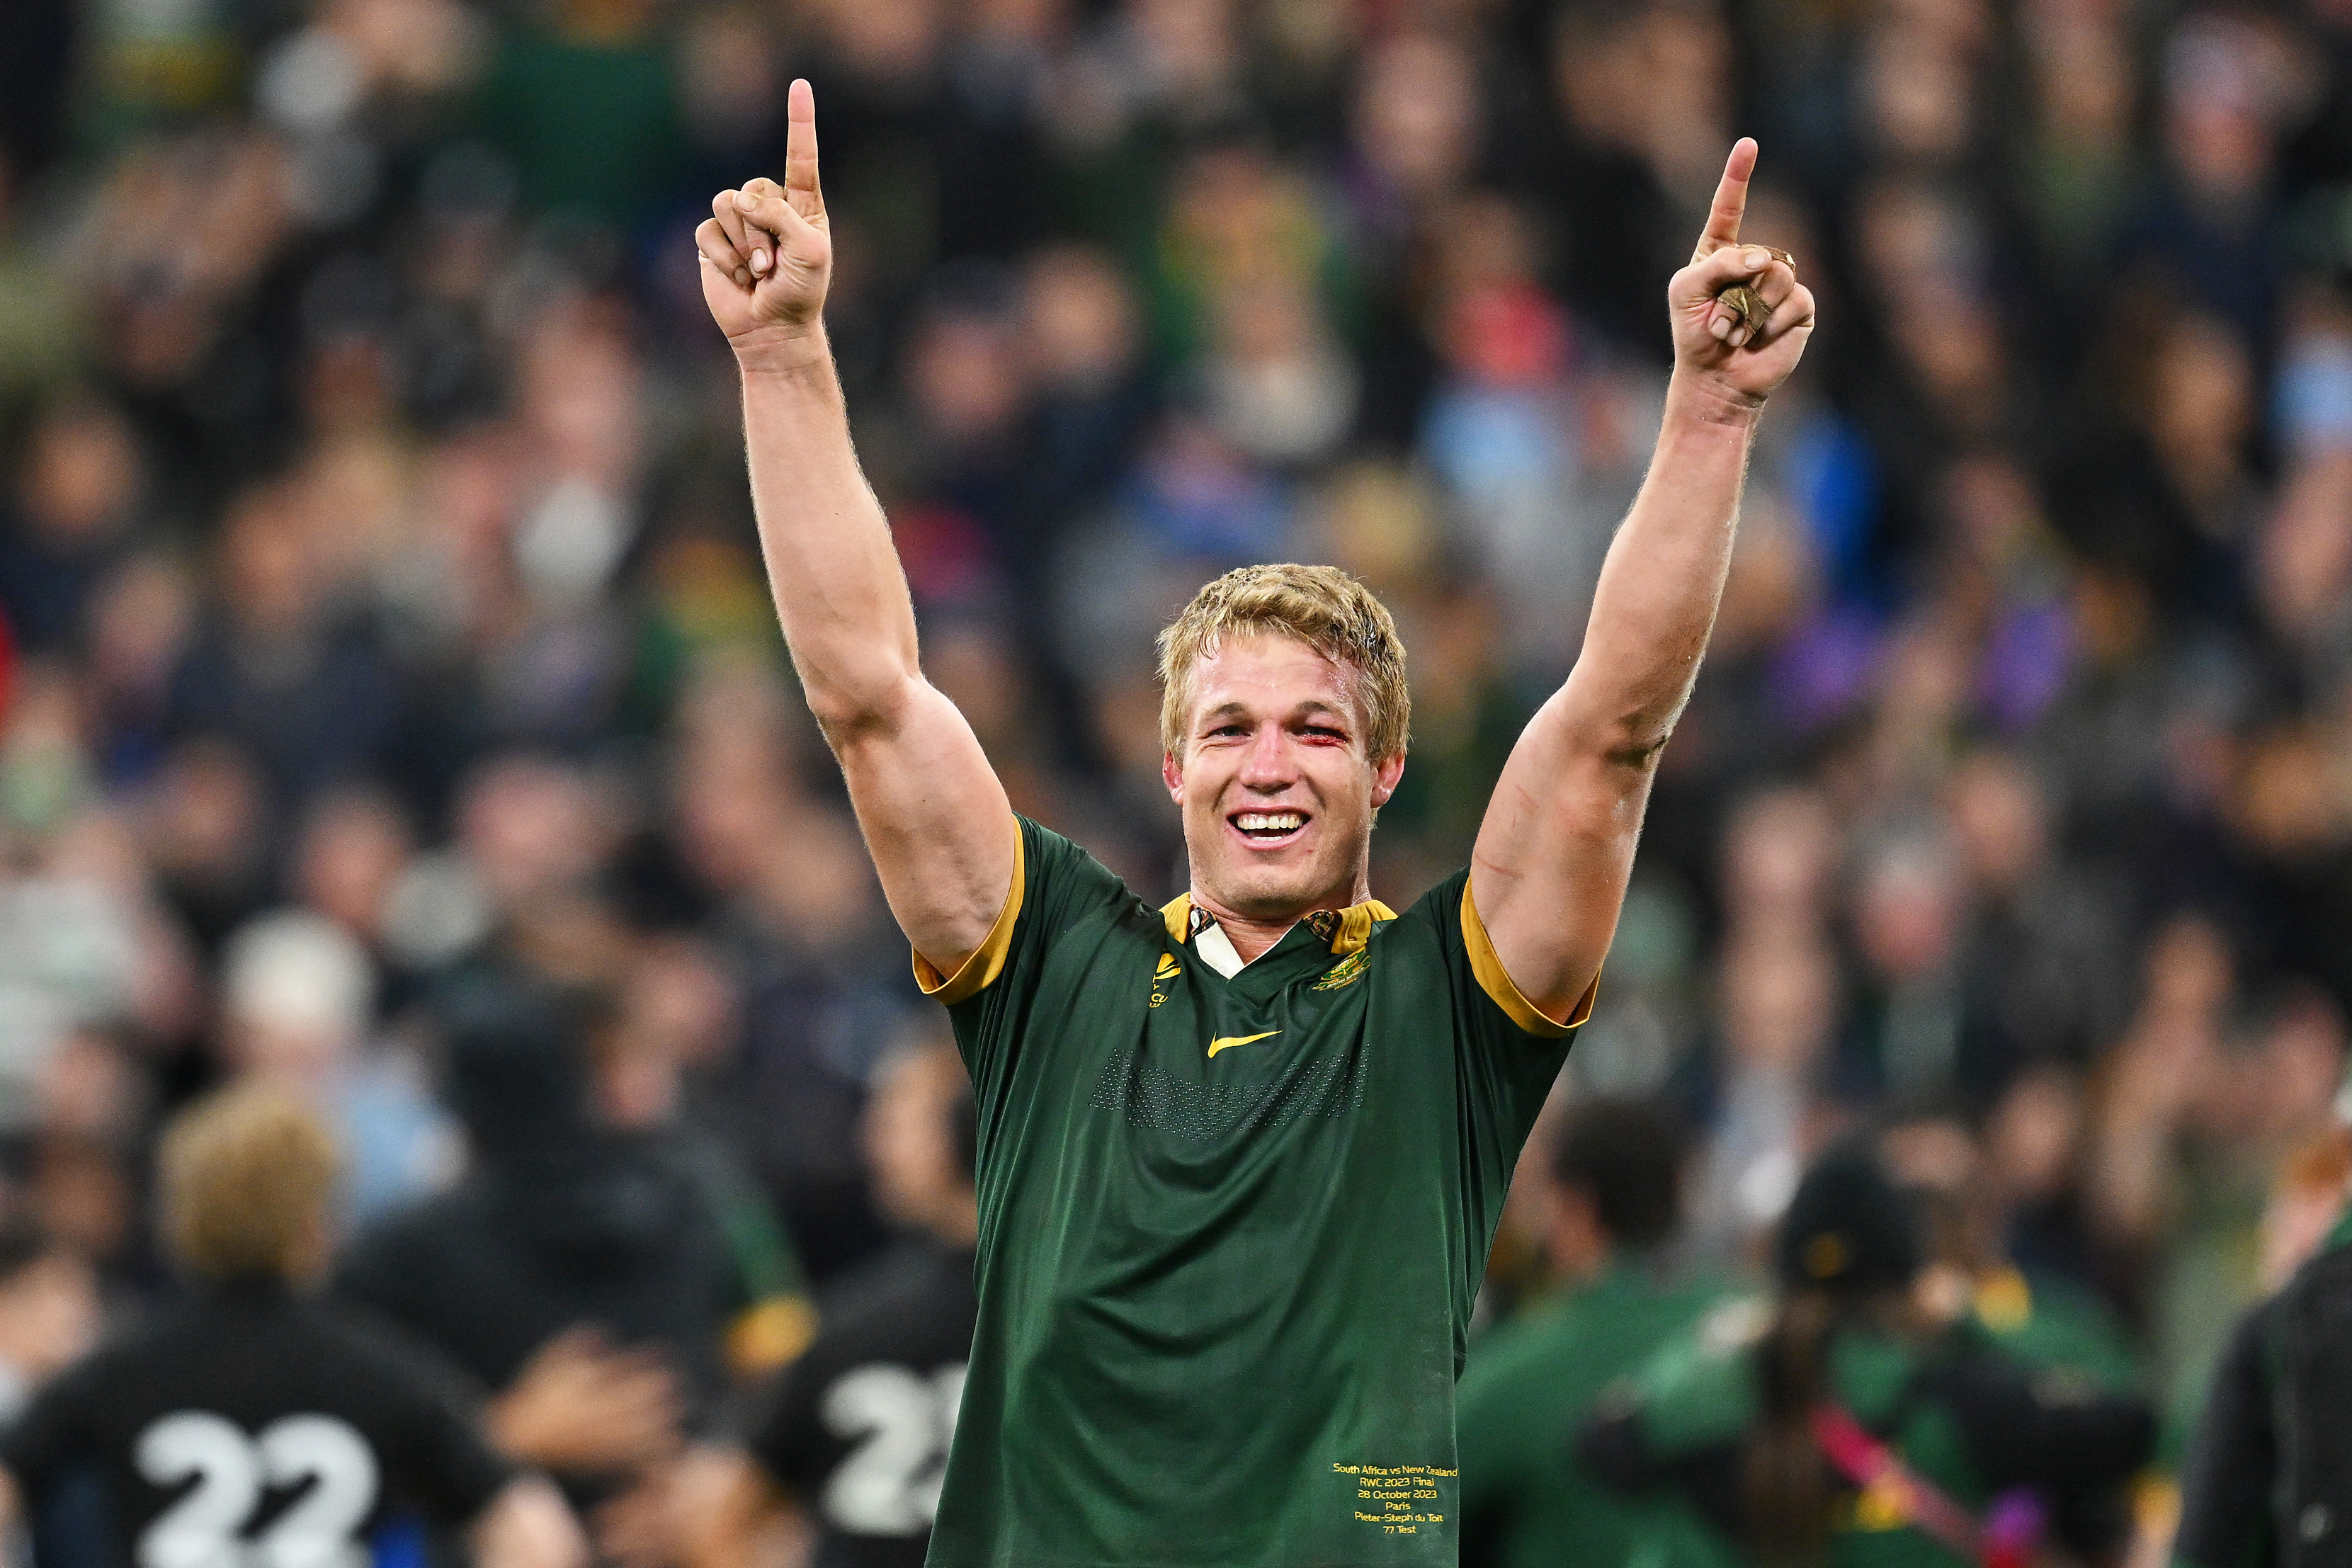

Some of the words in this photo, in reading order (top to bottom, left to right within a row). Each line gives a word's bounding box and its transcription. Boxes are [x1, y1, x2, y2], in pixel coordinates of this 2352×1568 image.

[1333, 1462, 1360, 1475] South
[1361, 1465, 1388, 1475] Africa
[1402, 1465, 1425, 1474] New
[1426, 1465, 1458, 1477] Zealand
[1360, 1477, 1383, 1487] RWC
[1384, 1477, 1411, 1487] 2023
[1412, 1477, 1436, 1487] Final
[133, 1411, 381, 1568] 22
[1358, 1489, 1372, 1499] 28
[1373, 1490, 1411, 1499] October
[1413, 1489, 1438, 1499] 2023
[1385, 1501, 1411, 1511] Paris
[1354, 1511, 1414, 1523] Pieter-Steph
[1415, 1513, 1426, 1522] du
[1427, 1513, 1444, 1523] Toit
[1382, 1526, 1395, 1534] 77
[1397, 1525, 1417, 1534] Test
